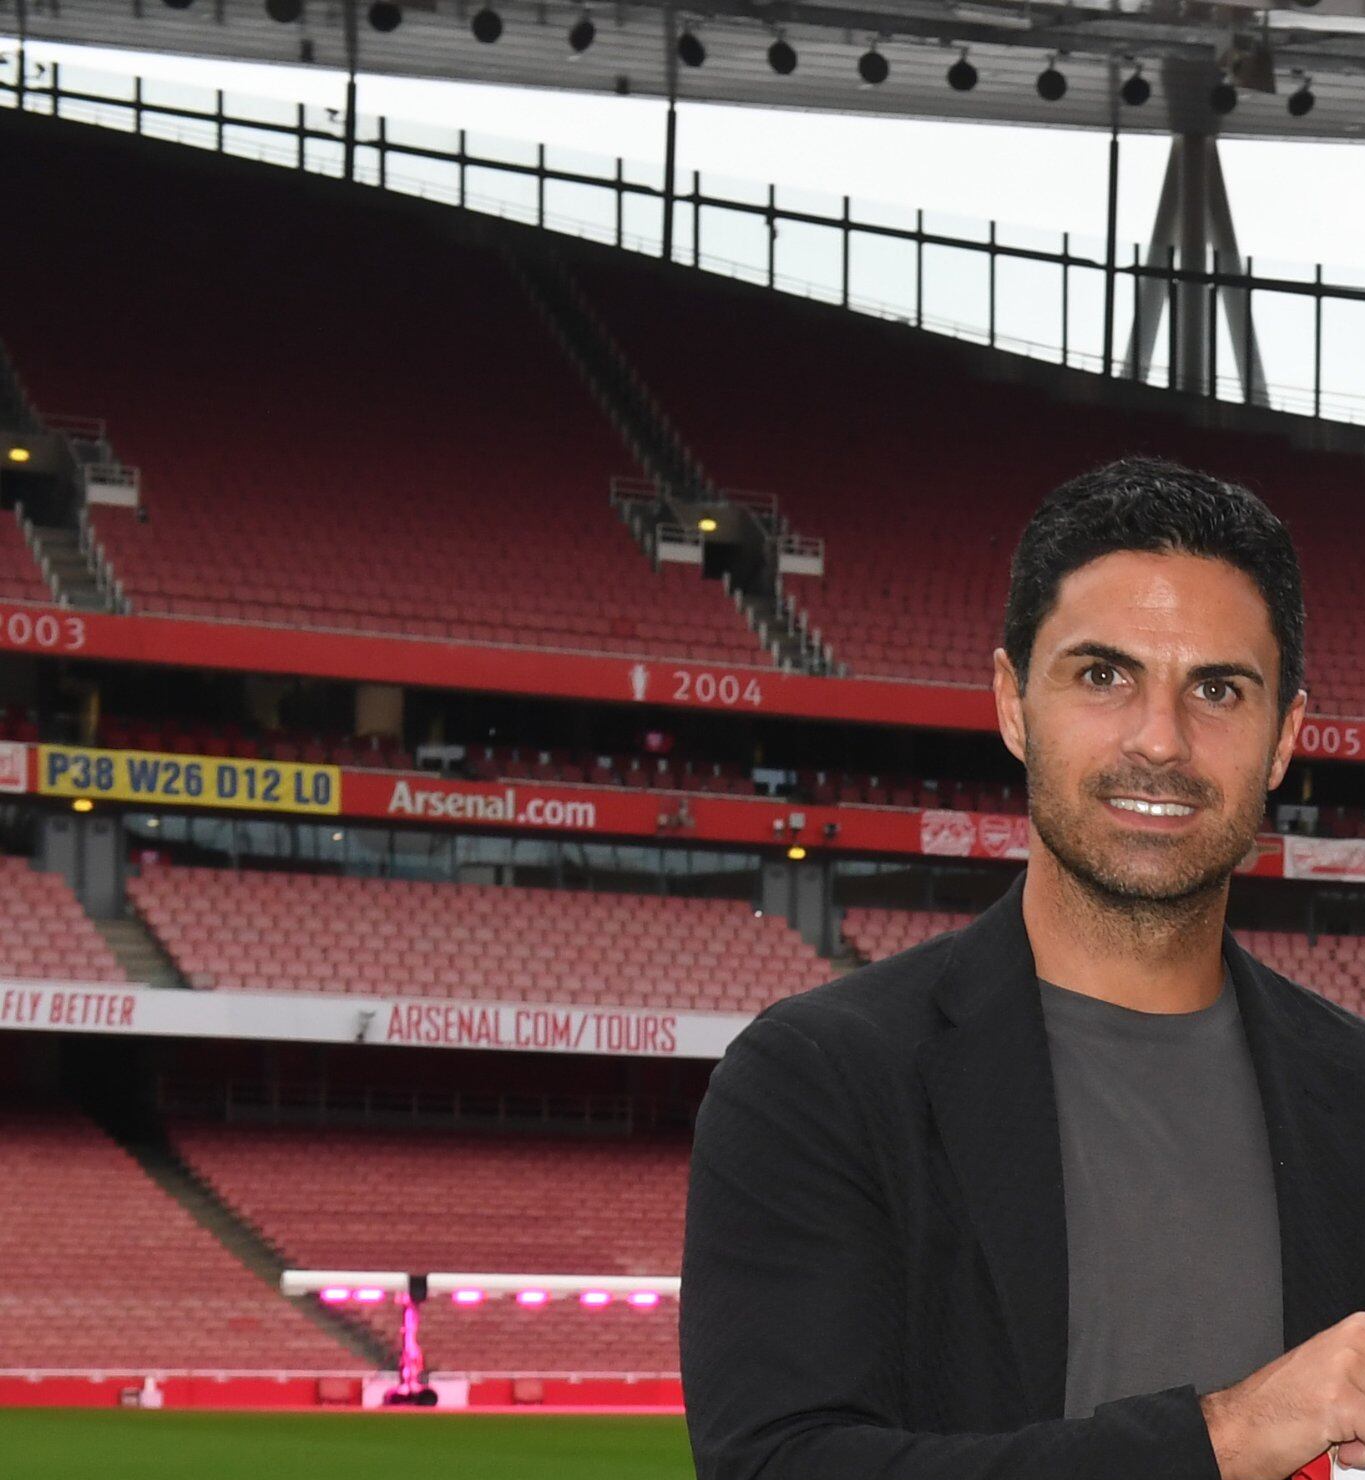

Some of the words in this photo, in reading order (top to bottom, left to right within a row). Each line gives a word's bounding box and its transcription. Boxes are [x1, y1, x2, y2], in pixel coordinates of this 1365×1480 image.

[0, 611, 85, 650] 003
[672, 669, 763, 706] 2004
[1301, 724, 1361, 756] 005
[49, 752, 114, 792] P38
[127, 757, 204, 798] W26
[216, 764, 282, 803] D12
[388, 780, 597, 830] Arsenal.com
[2, 990, 41, 1022] FLY
[49, 993, 137, 1028] BETTER
[387, 1003, 678, 1053] ARSENAL.COM/TOURS
